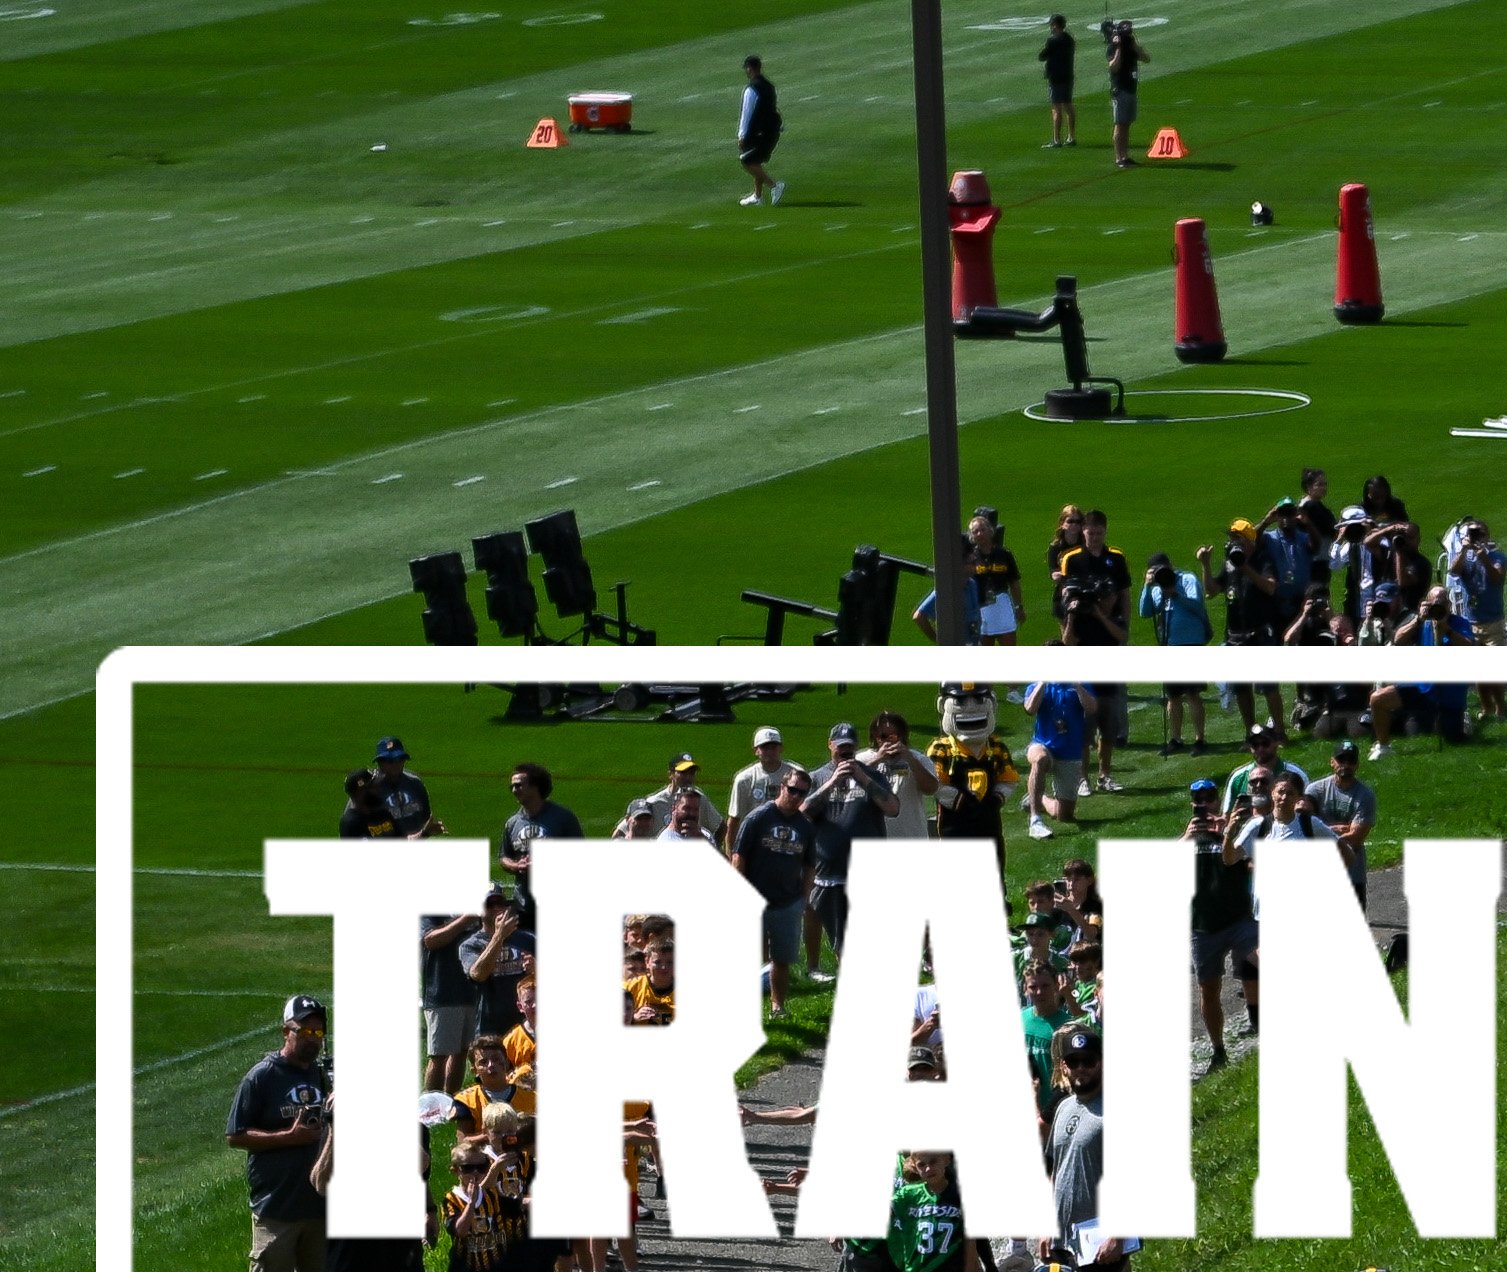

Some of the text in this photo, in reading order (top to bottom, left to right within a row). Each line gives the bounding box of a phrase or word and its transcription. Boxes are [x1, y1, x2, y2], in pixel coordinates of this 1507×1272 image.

[536, 125, 553, 144] 20
[1158, 136, 1175, 155] 10
[908, 1204, 962, 1217] RIVERSID
[917, 1222, 955, 1255] 37
